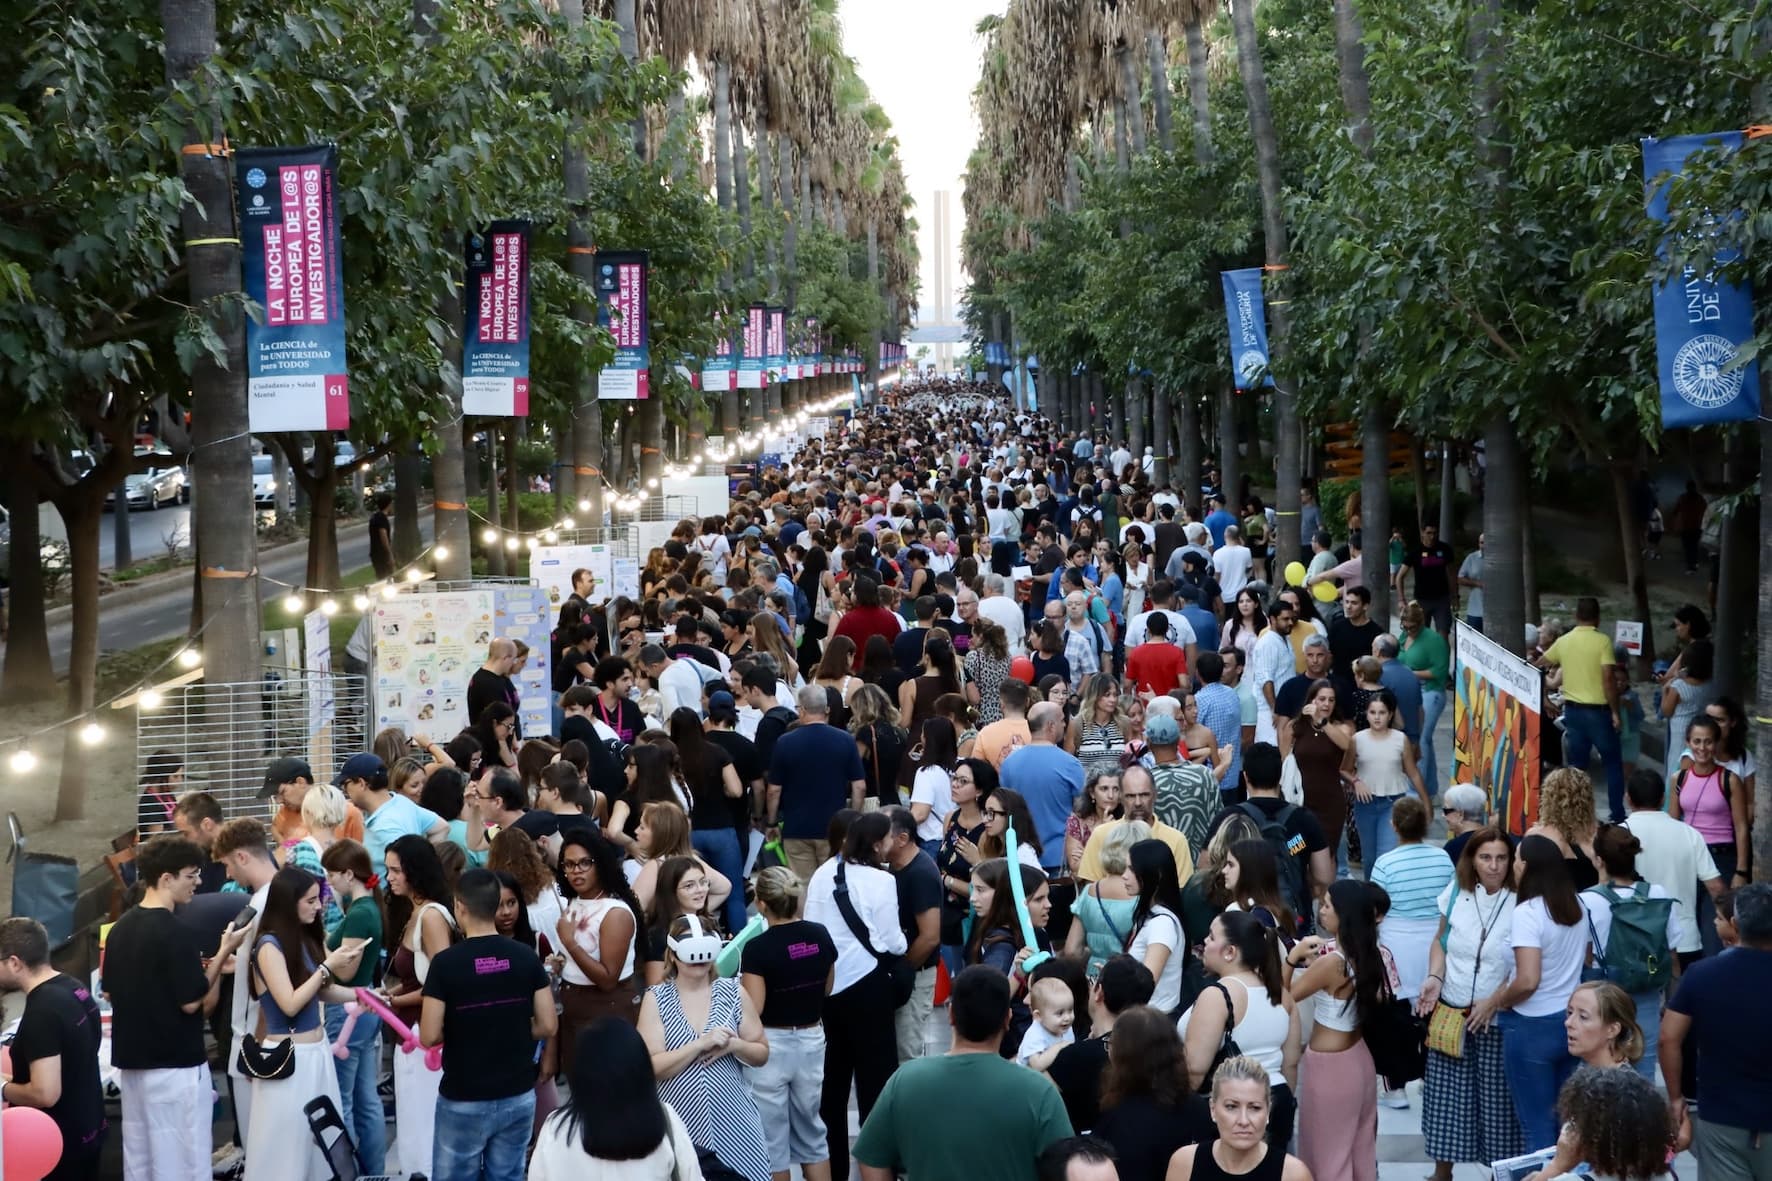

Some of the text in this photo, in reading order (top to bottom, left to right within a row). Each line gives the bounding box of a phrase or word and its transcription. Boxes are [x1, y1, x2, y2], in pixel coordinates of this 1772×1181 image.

[283, 170, 304, 320] EUROPEA DE L@S
[304, 169, 325, 320] INVESTIGADOR@S
[266, 229, 285, 322] LA NOCHE
[494, 264, 504, 280] DE
[506, 237, 518, 340] INVESTIGADOR@S
[621, 288, 630, 300] DE
[480, 276, 491, 340] LA NOCHE
[494, 284, 504, 340] EUROPEA
[1702, 292, 1720, 320] DE
[270, 350, 332, 360] UNIVERSIDAD
[271, 341, 307, 350] CIENCIA
[308, 340, 318, 348] de
[278, 360, 310, 369] TODOS
[330, 384, 343, 396] 61
[516, 384, 527, 392] 59
